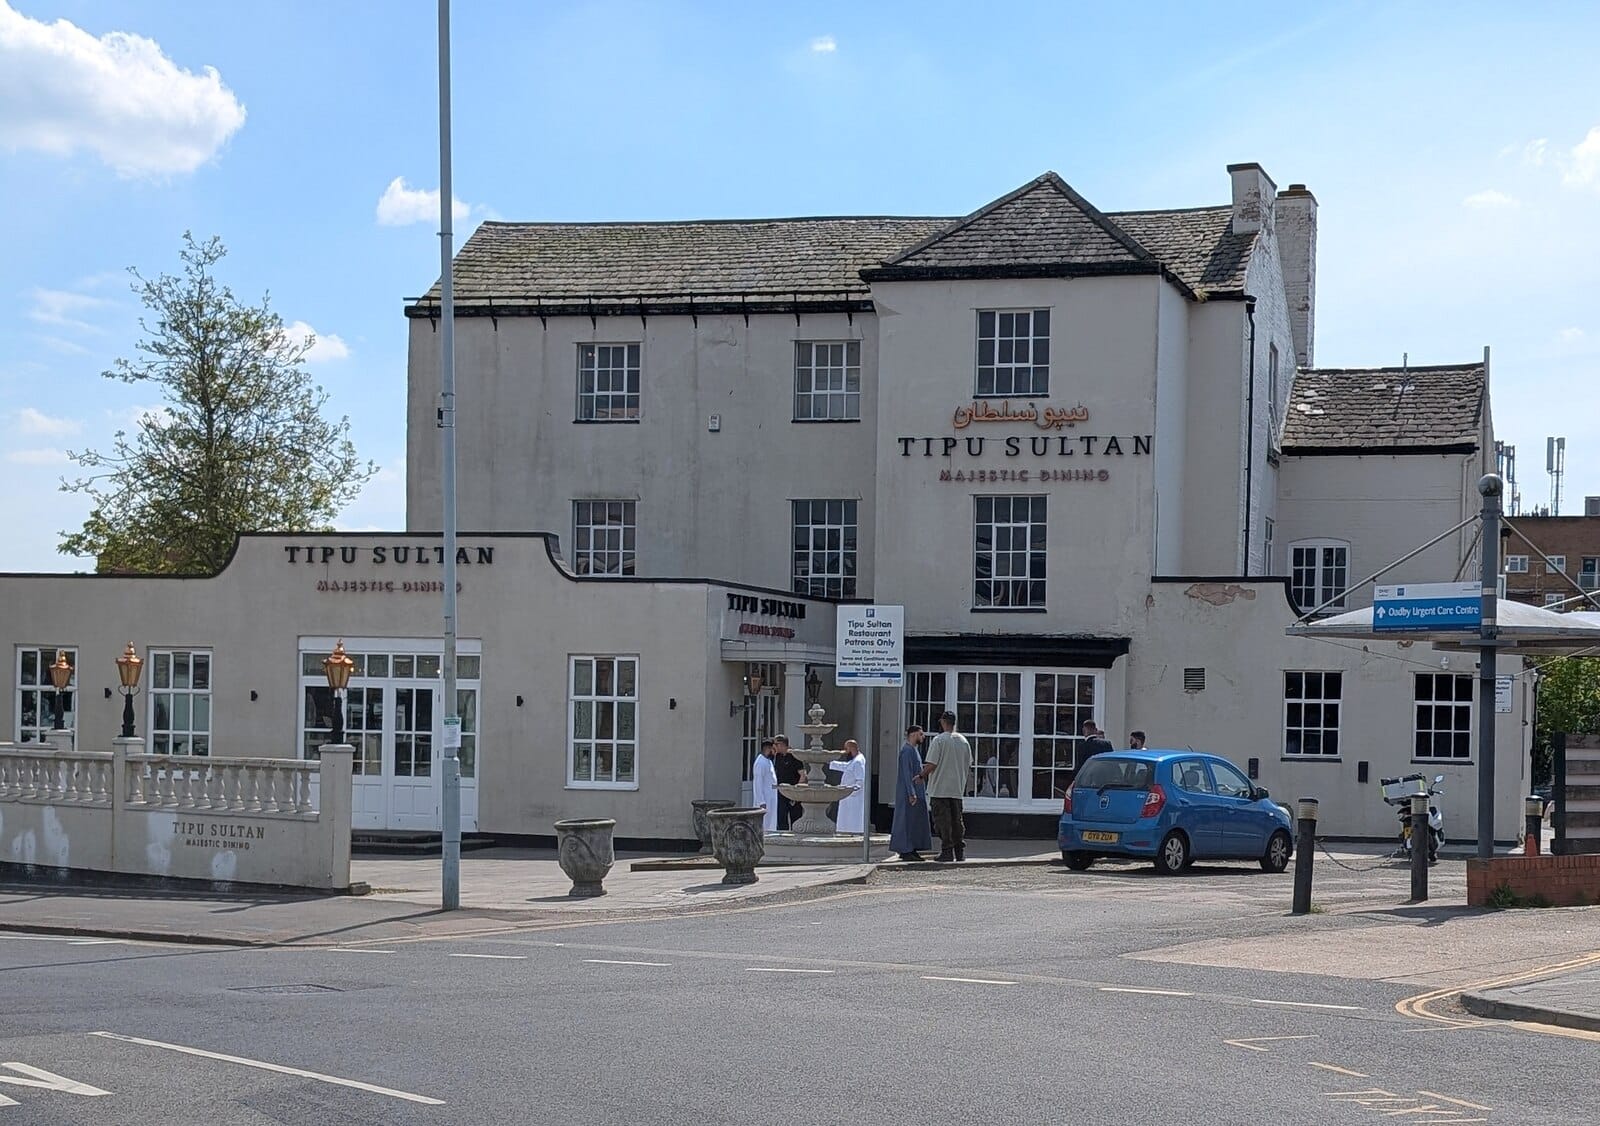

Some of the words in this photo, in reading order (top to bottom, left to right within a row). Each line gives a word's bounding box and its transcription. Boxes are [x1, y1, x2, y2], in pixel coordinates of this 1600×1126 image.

[898, 437, 985, 457] TIPU
[1005, 435, 1153, 457] SULTAN
[939, 469, 1029, 482] MAJESTIC
[1039, 469, 1110, 482] DINING
[284, 546, 358, 564] TIPU
[372, 546, 495, 565] SULTAN
[317, 580, 394, 593] MAJESTIC
[727, 593, 759, 613] TIPU
[760, 599, 806, 619] SULTAN
[1388, 607, 1412, 618] Oadby
[1412, 606, 1436, 618] Urgent
[1437, 606, 1454, 615] Care
[1455, 605, 1479, 615] Centre
[848, 620, 865, 629] Tipu
[866, 620, 892, 628] Sultan
[876, 639, 895, 648] Only
[172, 821, 205, 835] TIPU
[210, 824, 265, 839] SULTAN
[186, 839, 219, 848] MAJESTIC
[223, 840, 250, 850] DINING
